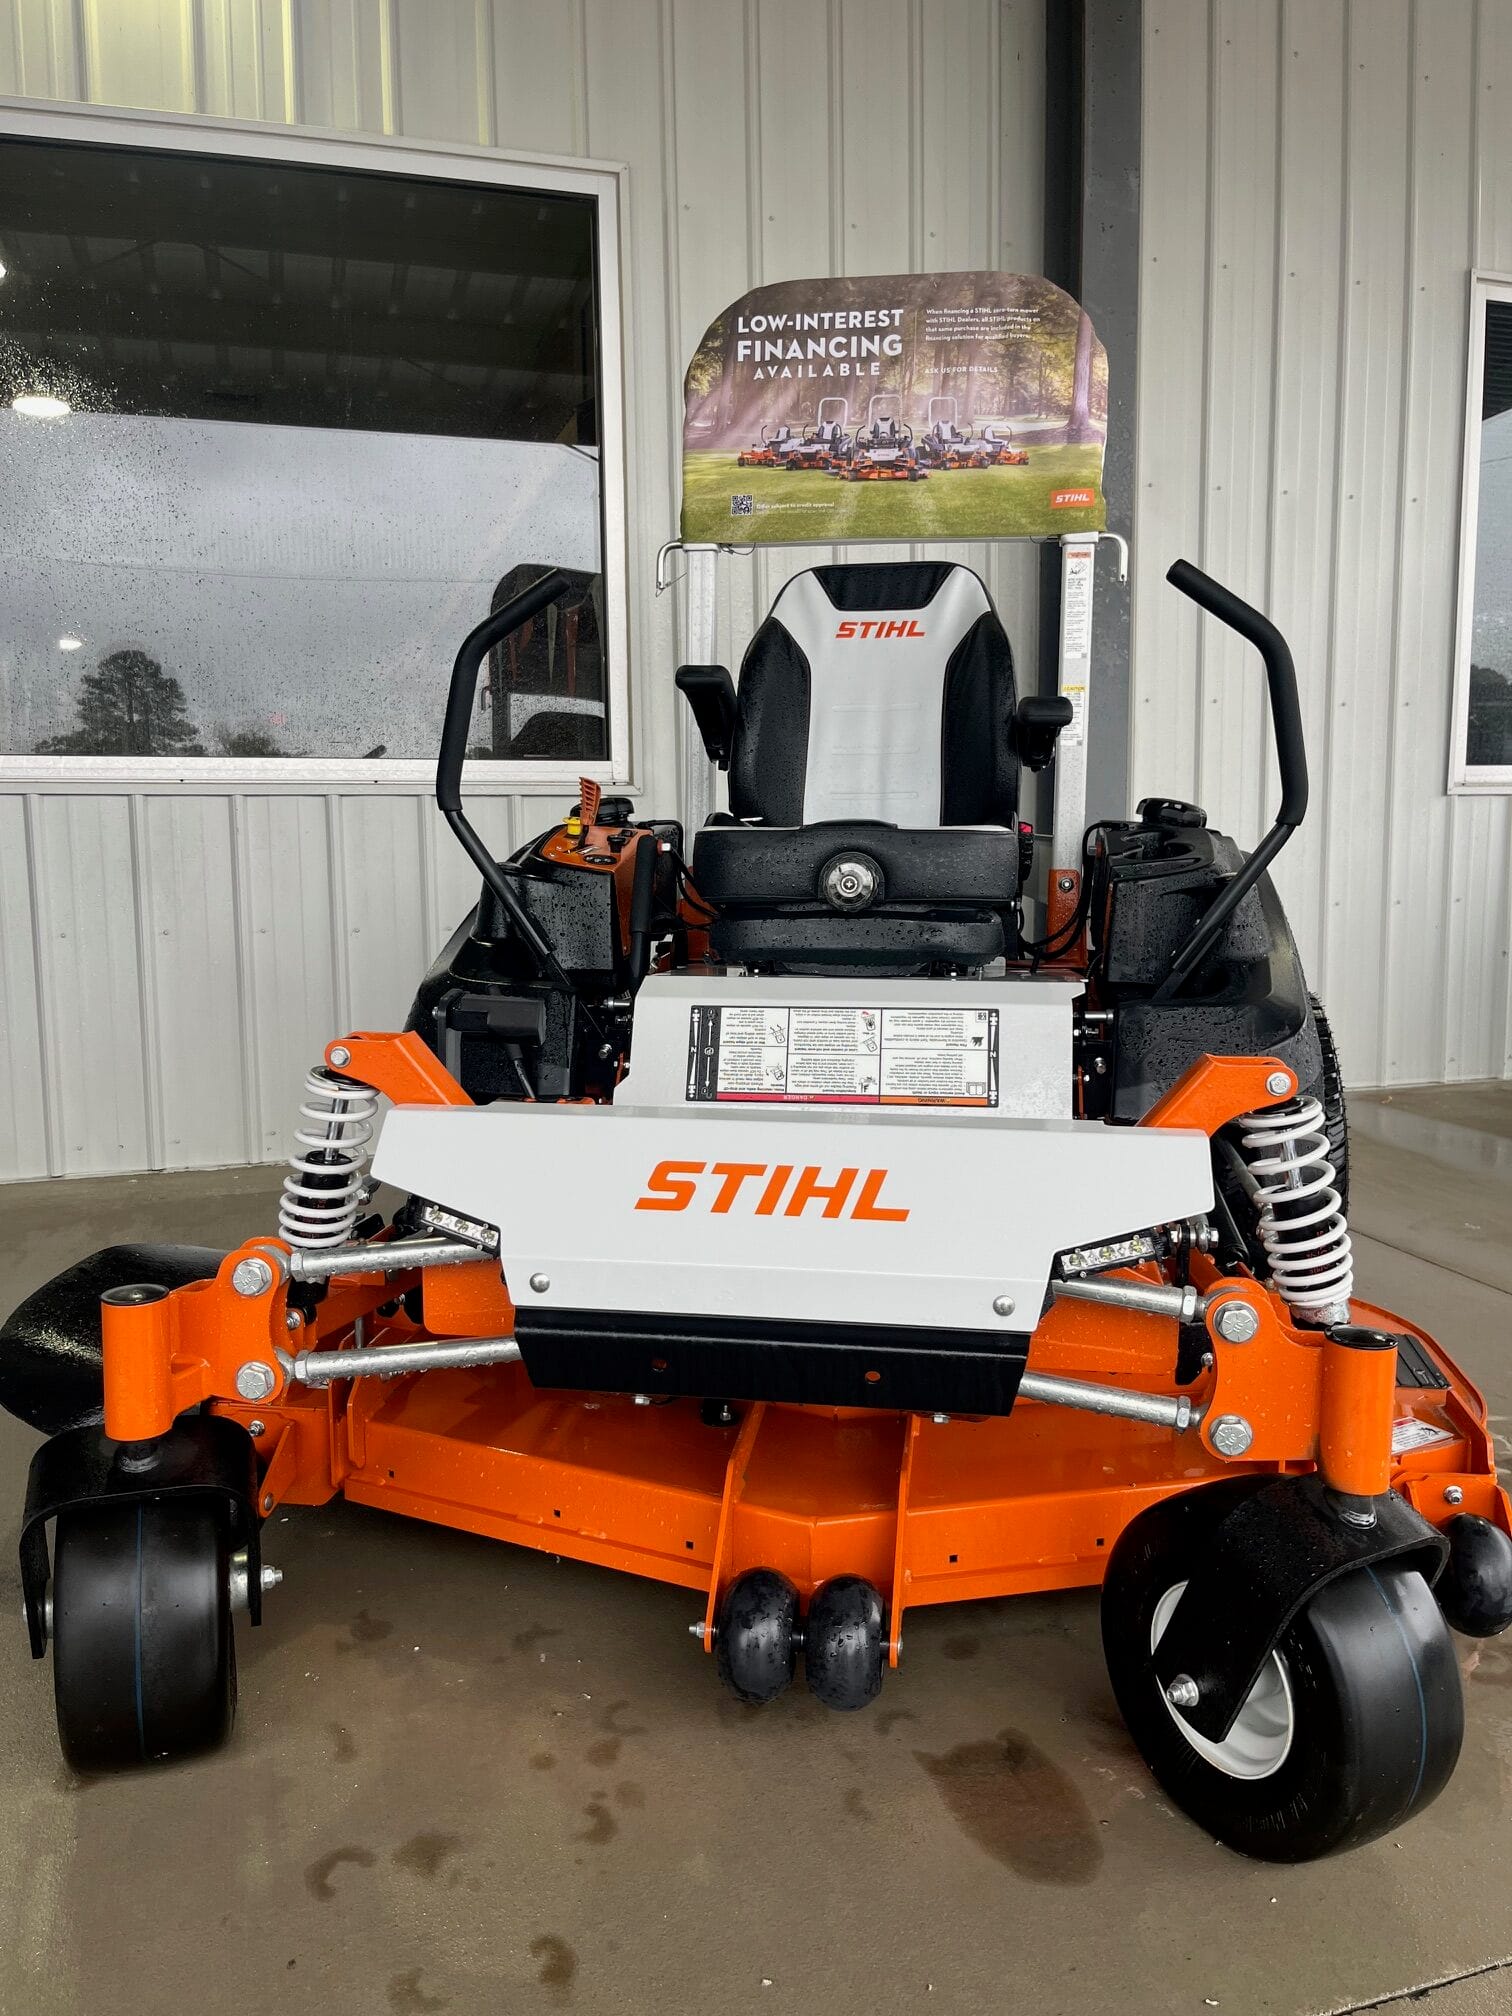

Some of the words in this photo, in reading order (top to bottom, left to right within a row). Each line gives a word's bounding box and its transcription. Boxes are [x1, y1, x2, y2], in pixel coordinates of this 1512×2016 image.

[738, 309, 903, 333] LOW-INTEREST
[985, 333, 1008, 341] qualified
[737, 334, 902, 362] FINANCING
[753, 363, 880, 380] AVAILABLE
[1055, 492, 1090, 505] STIHL
[835, 621, 926, 639] STIHL
[634, 1160, 910, 1222] STIHL
